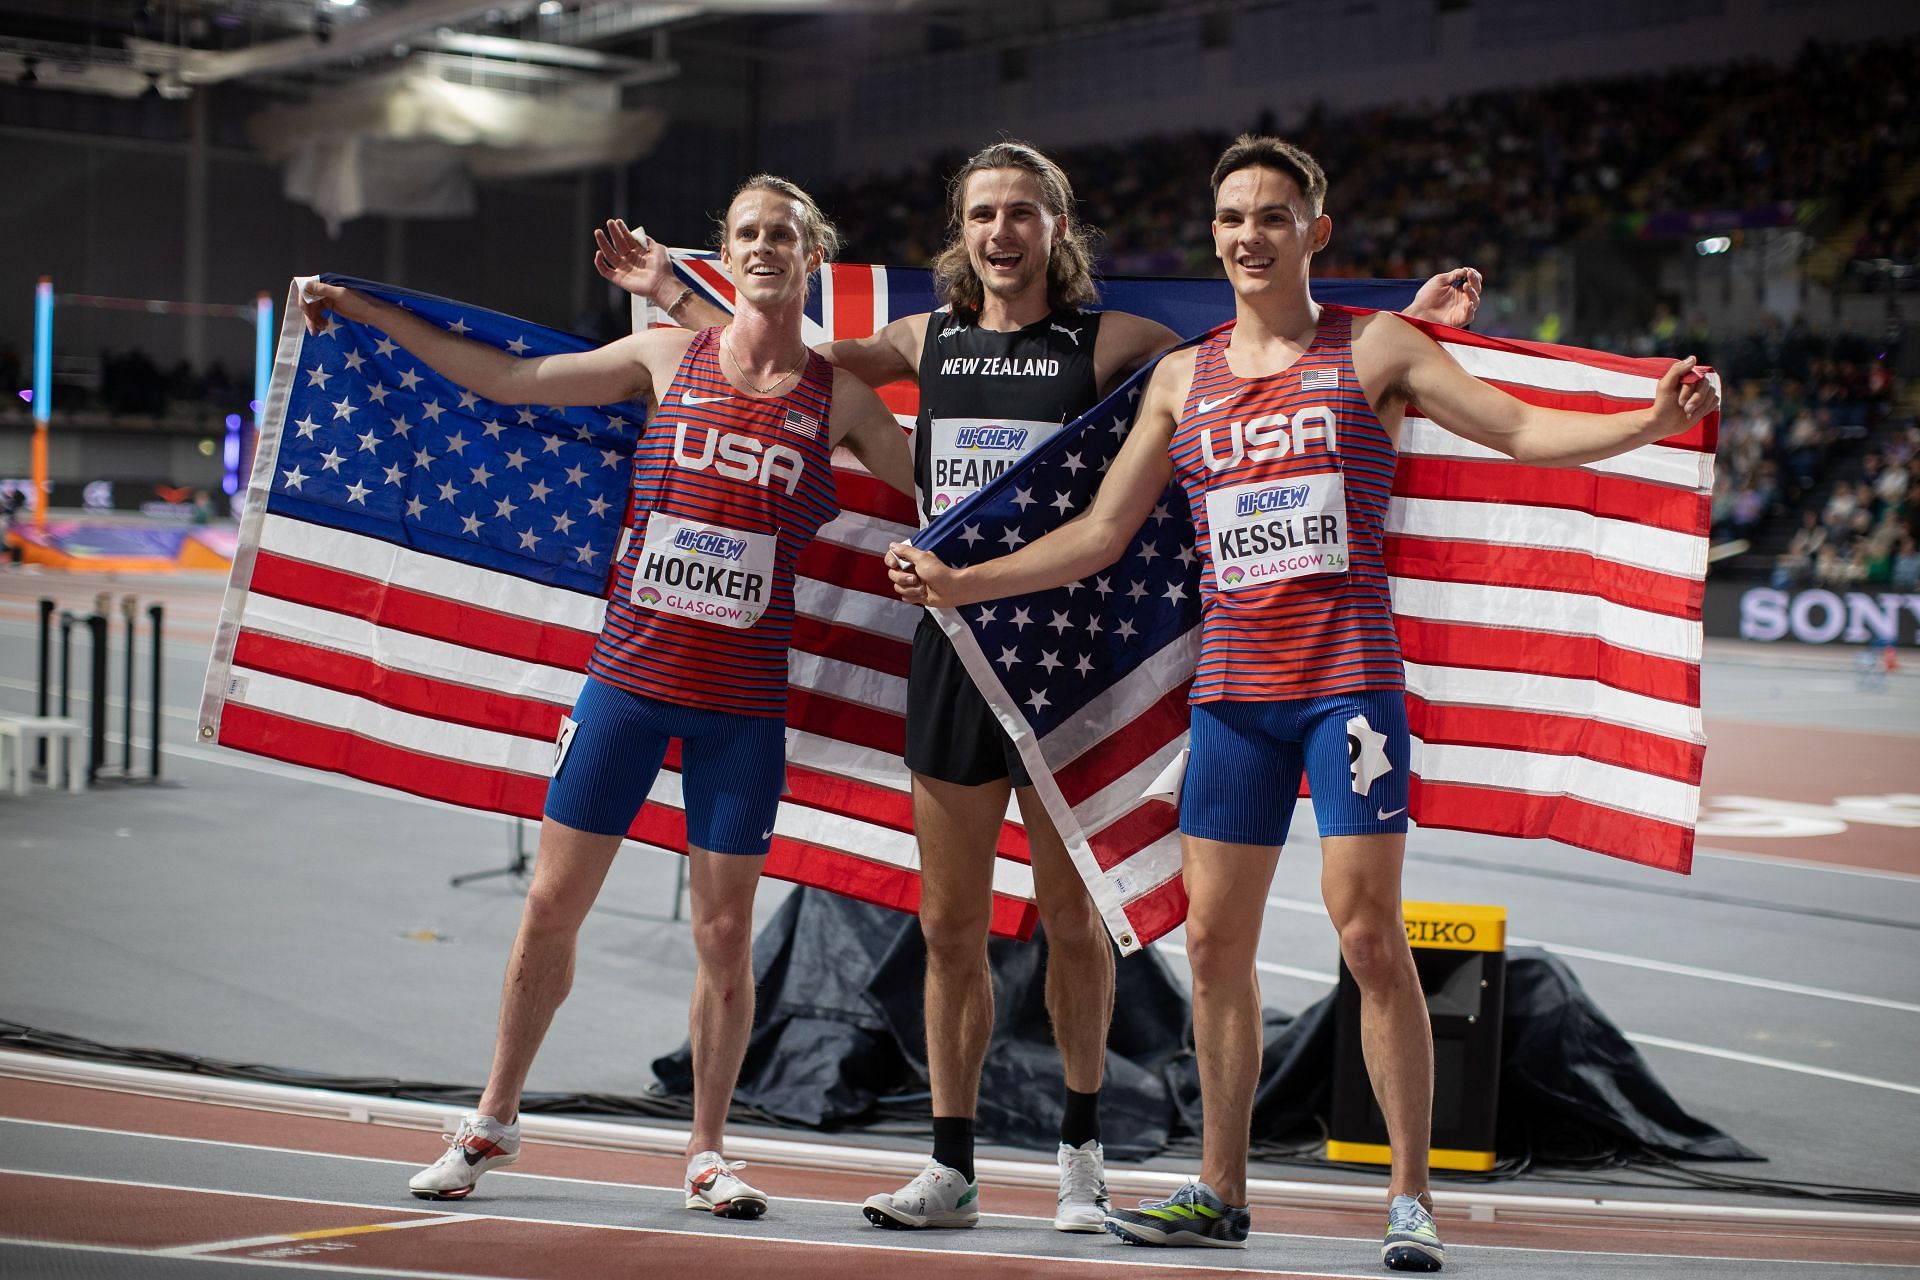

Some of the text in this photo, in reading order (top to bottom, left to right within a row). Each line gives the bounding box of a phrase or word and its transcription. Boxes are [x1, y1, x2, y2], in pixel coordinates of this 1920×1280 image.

[940, 357, 1059, 377] NEW ZEALAND
[954, 426, 1029, 451] HI-CHEW
[1200, 405, 1337, 473] USA
[673, 422, 805, 497] USA
[936, 458, 1014, 487] BEAM
[1235, 484, 1311, 517] HI-CHEW
[673, 527, 748, 562] HI-CHEW
[1217, 514, 1339, 561] KESSLER
[643, 552, 764, 604] HOCKER
[1249, 553, 1345, 578] GLASGOW 24
[666, 595, 742, 621] GLASGOW
[1403, 920, 1476, 944] EIKO
